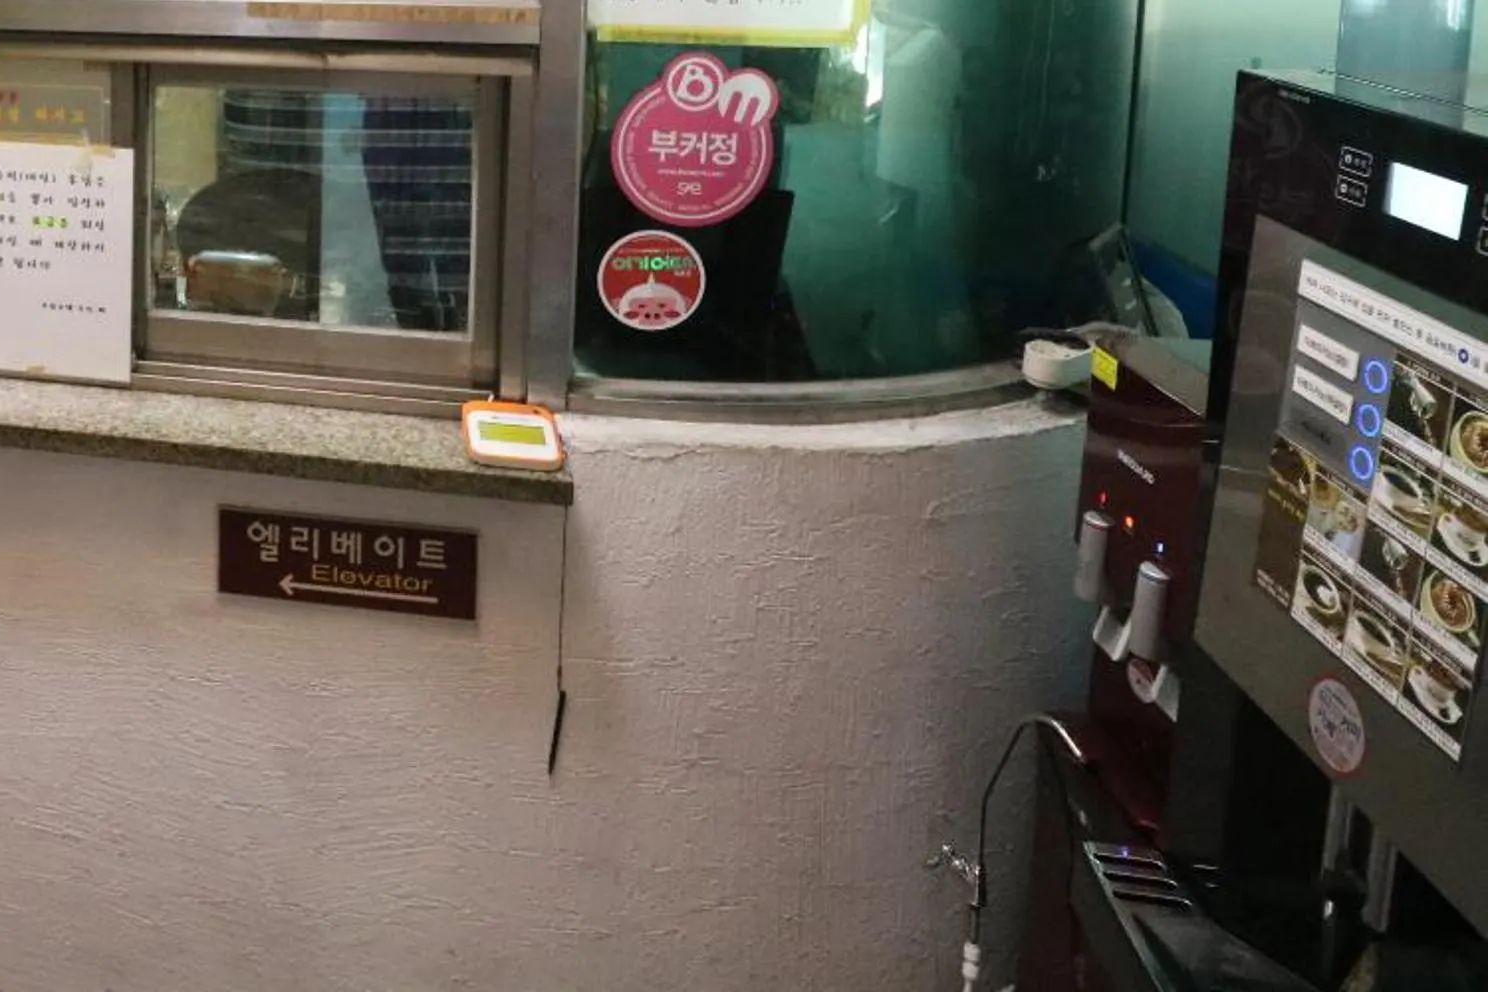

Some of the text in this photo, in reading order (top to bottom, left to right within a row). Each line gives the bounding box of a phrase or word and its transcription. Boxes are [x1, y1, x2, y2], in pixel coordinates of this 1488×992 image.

[647, 128, 739, 166] 부커정
[245, 520, 449, 570] 엘리베이트
[311, 564, 433, 592] Elevator
